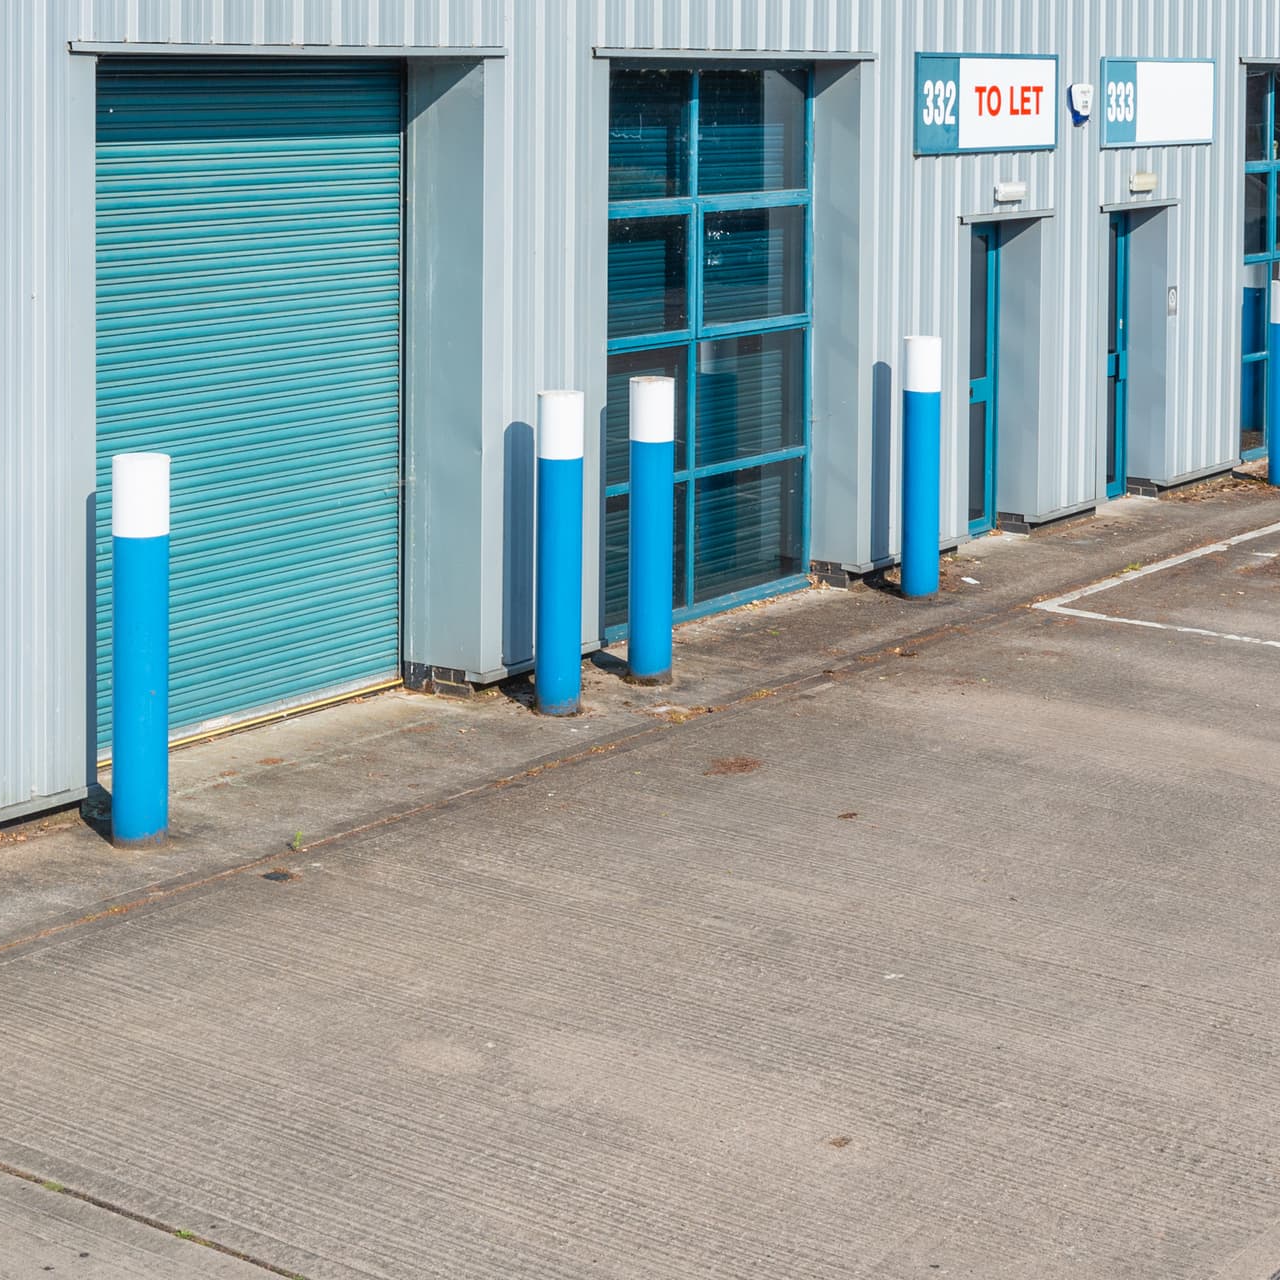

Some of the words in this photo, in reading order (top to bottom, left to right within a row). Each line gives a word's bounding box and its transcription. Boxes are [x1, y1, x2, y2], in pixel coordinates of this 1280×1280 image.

[923, 80, 956, 125] 332
[975, 85, 1002, 117] TO
[1009, 85, 1044, 116] LET
[1107, 81, 1134, 122] 333
